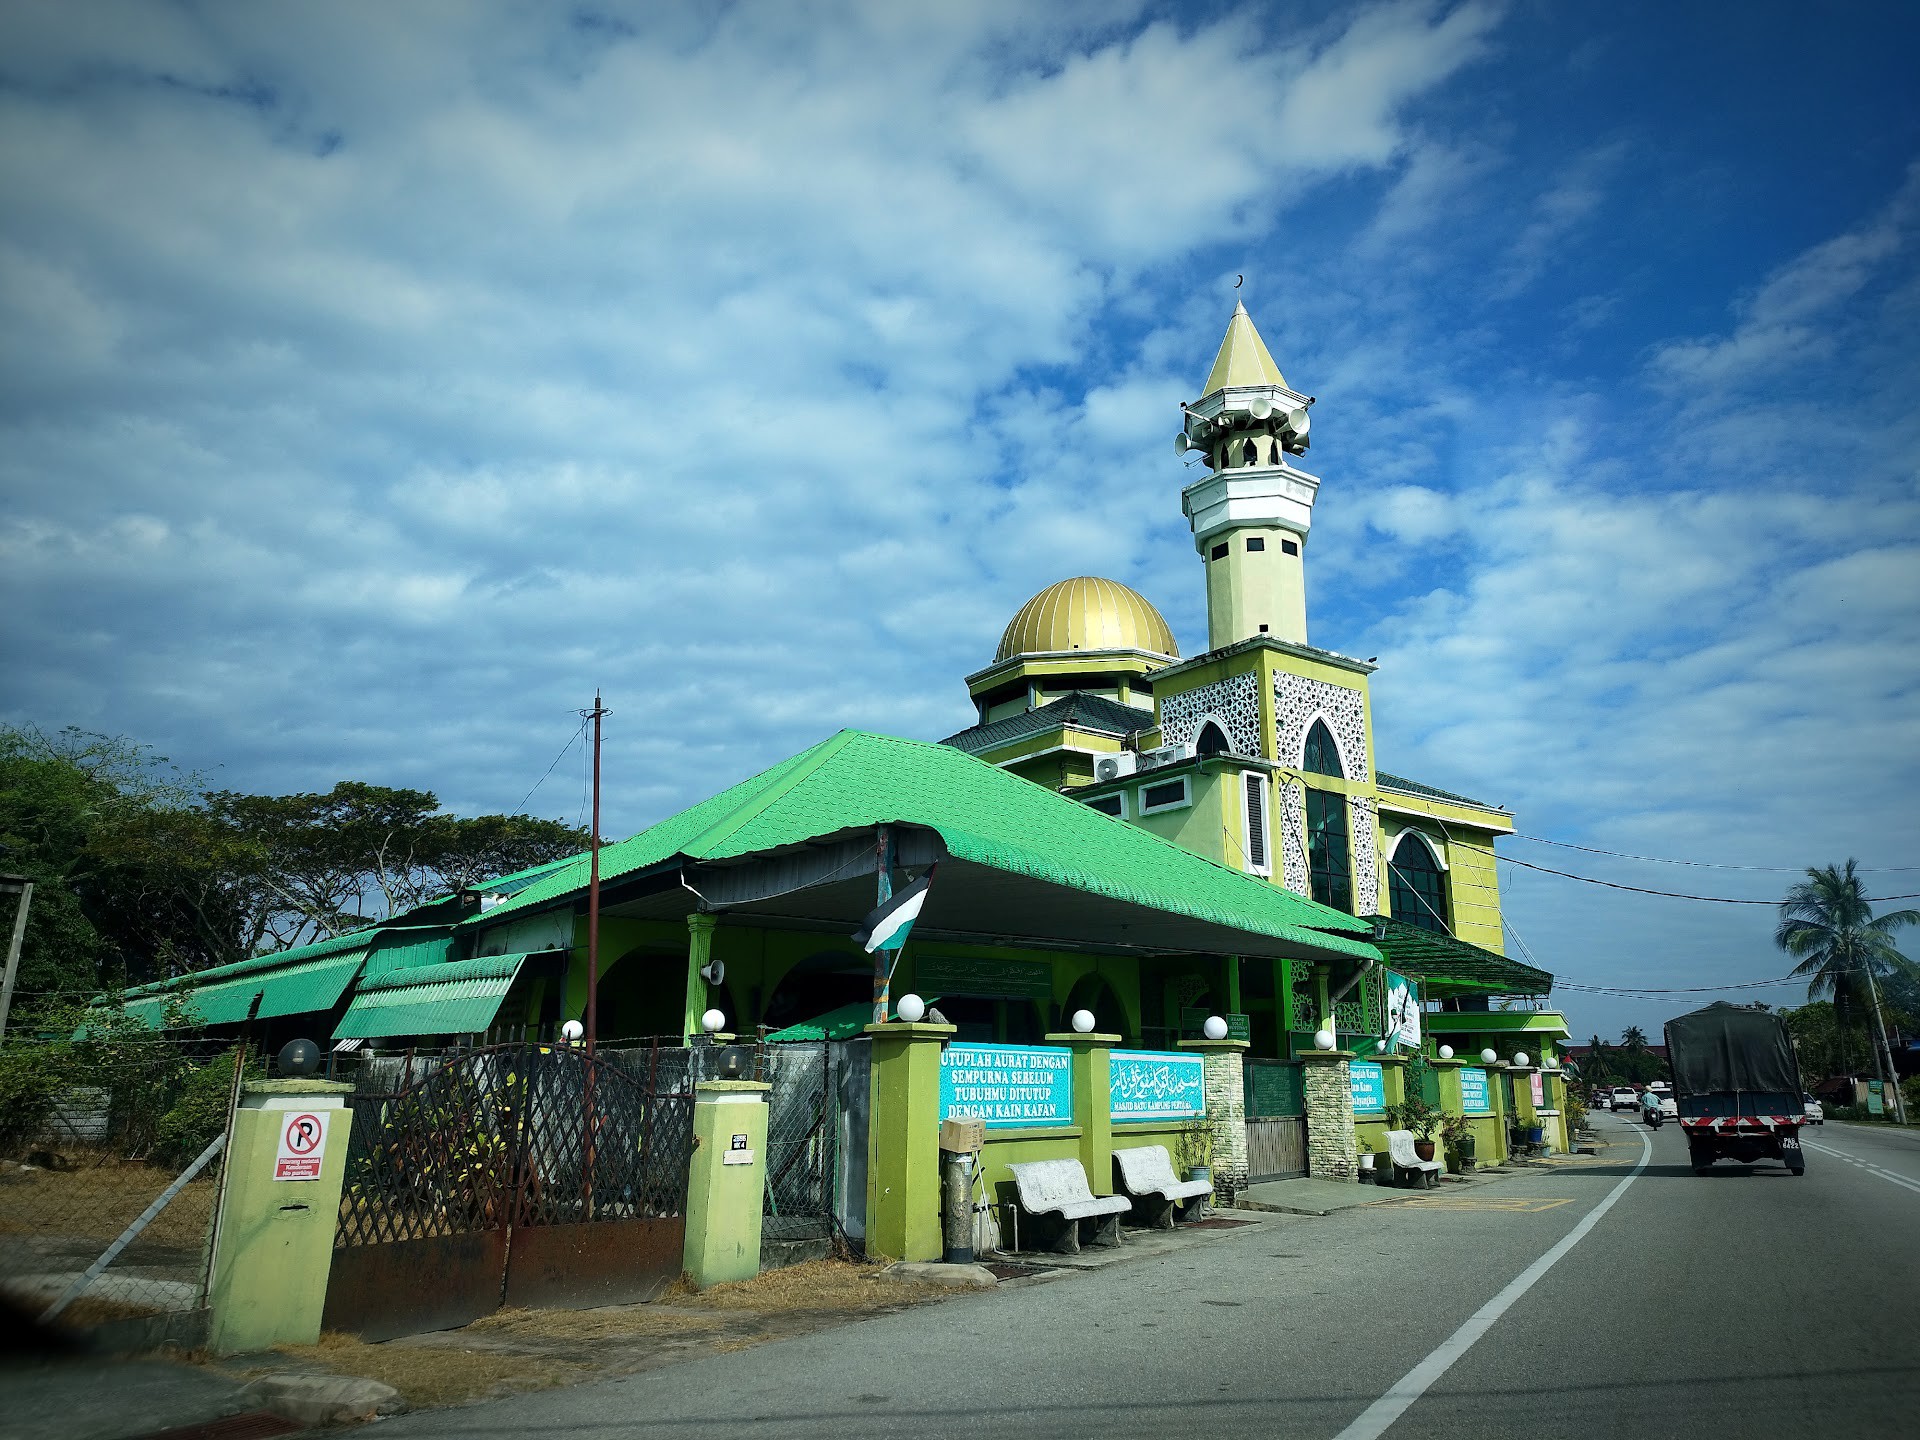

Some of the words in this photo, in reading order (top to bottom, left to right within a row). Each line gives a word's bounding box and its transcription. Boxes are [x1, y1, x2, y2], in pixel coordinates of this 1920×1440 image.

[941, 1052, 991, 1067] UTUPLAH
[994, 1054, 1028, 1068] AURAT
[1029, 1055, 1068, 1069] DENGAN
[951, 1069, 1009, 1084] SEMPURNA
[1011, 1071, 1054, 1085] SEBELUM
[955, 1087, 1007, 1101] TUBUHMU
[1009, 1088, 1051, 1101] DITUTUP
[948, 1104, 993, 1118] DENGAN
[995, 1104, 1021, 1117] KAIN
[1024, 1103, 1056, 1117] KAFAN
[1114, 1102, 1134, 1111] MASJID
[1134, 1102, 1147, 1110] BATU
[1148, 1101, 1171, 1110] KAMPUNG
